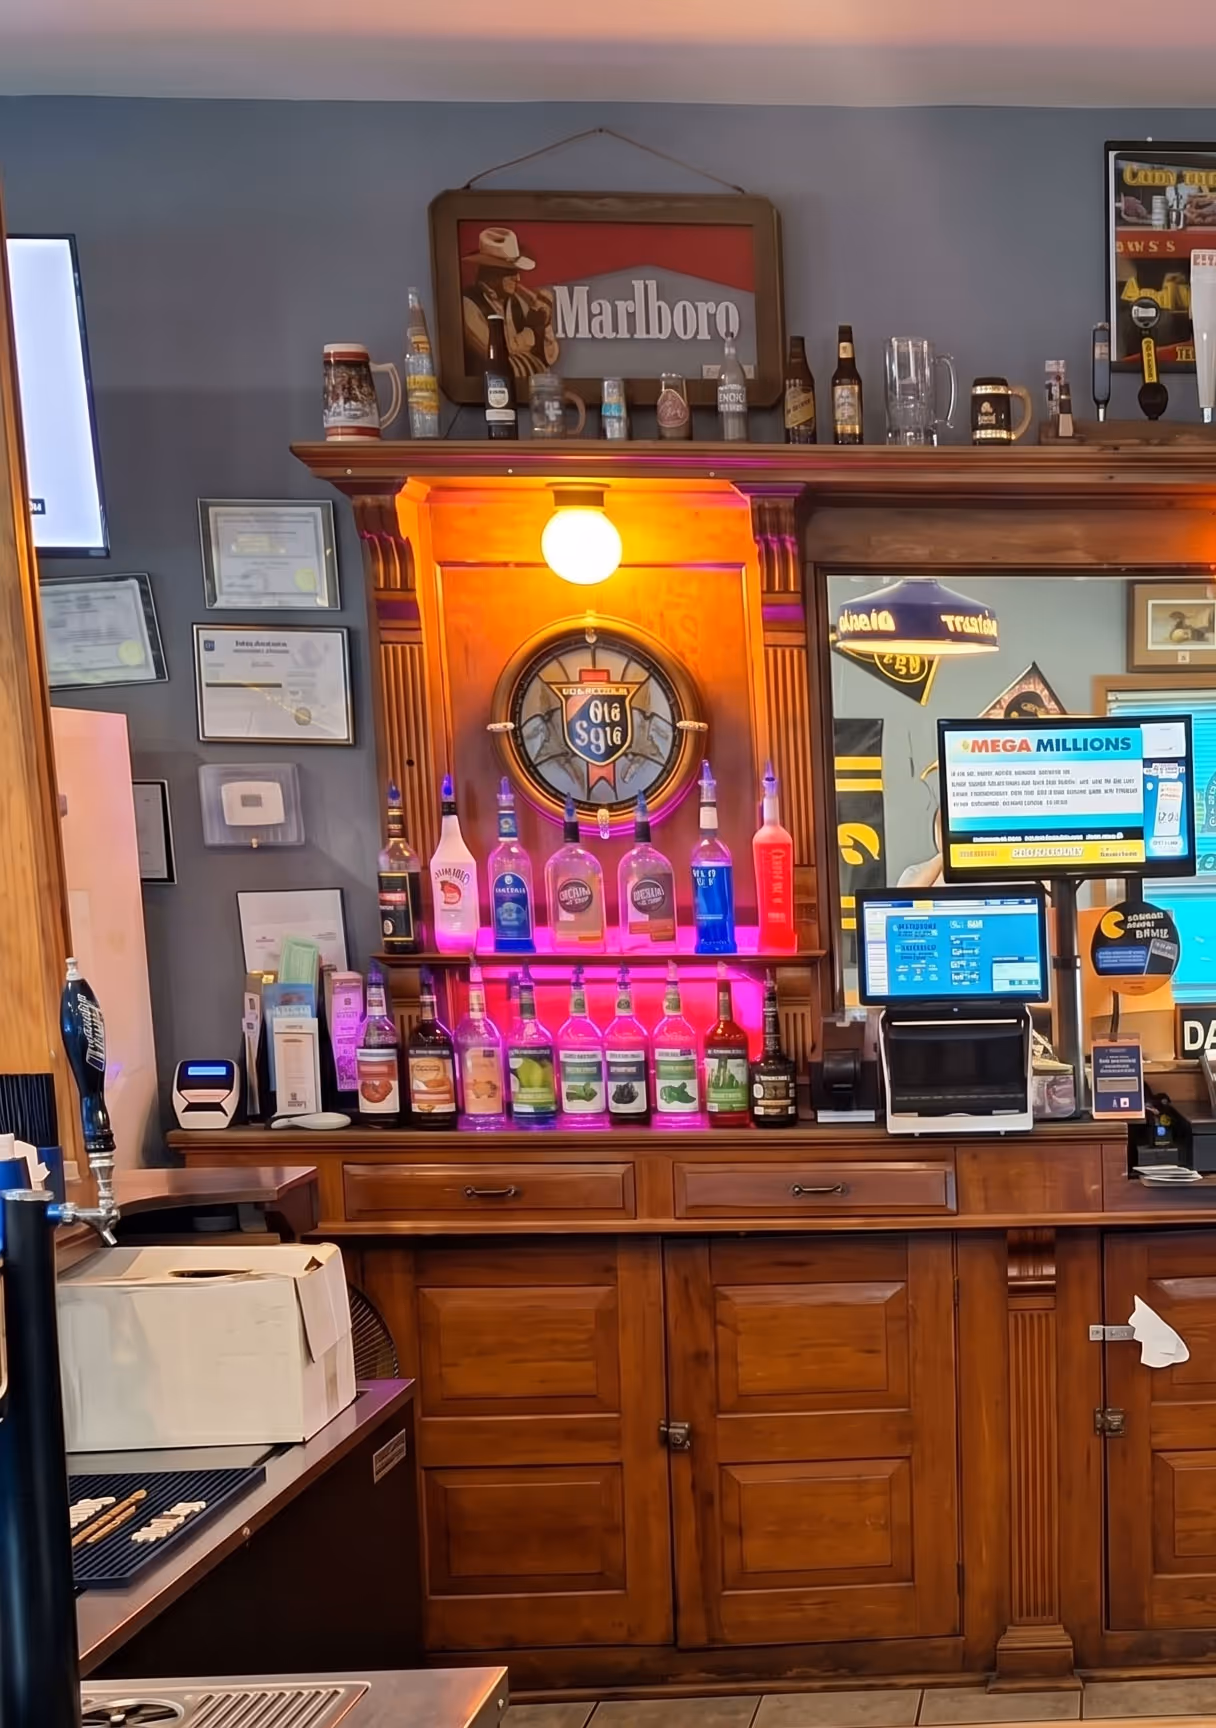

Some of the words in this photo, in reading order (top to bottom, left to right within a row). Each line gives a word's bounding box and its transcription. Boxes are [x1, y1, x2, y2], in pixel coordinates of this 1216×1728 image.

[552, 279, 740, 340] Marlboro
[970, 738, 1032, 753] MEGA
[1035, 736, 1132, 752] MILLIONS
